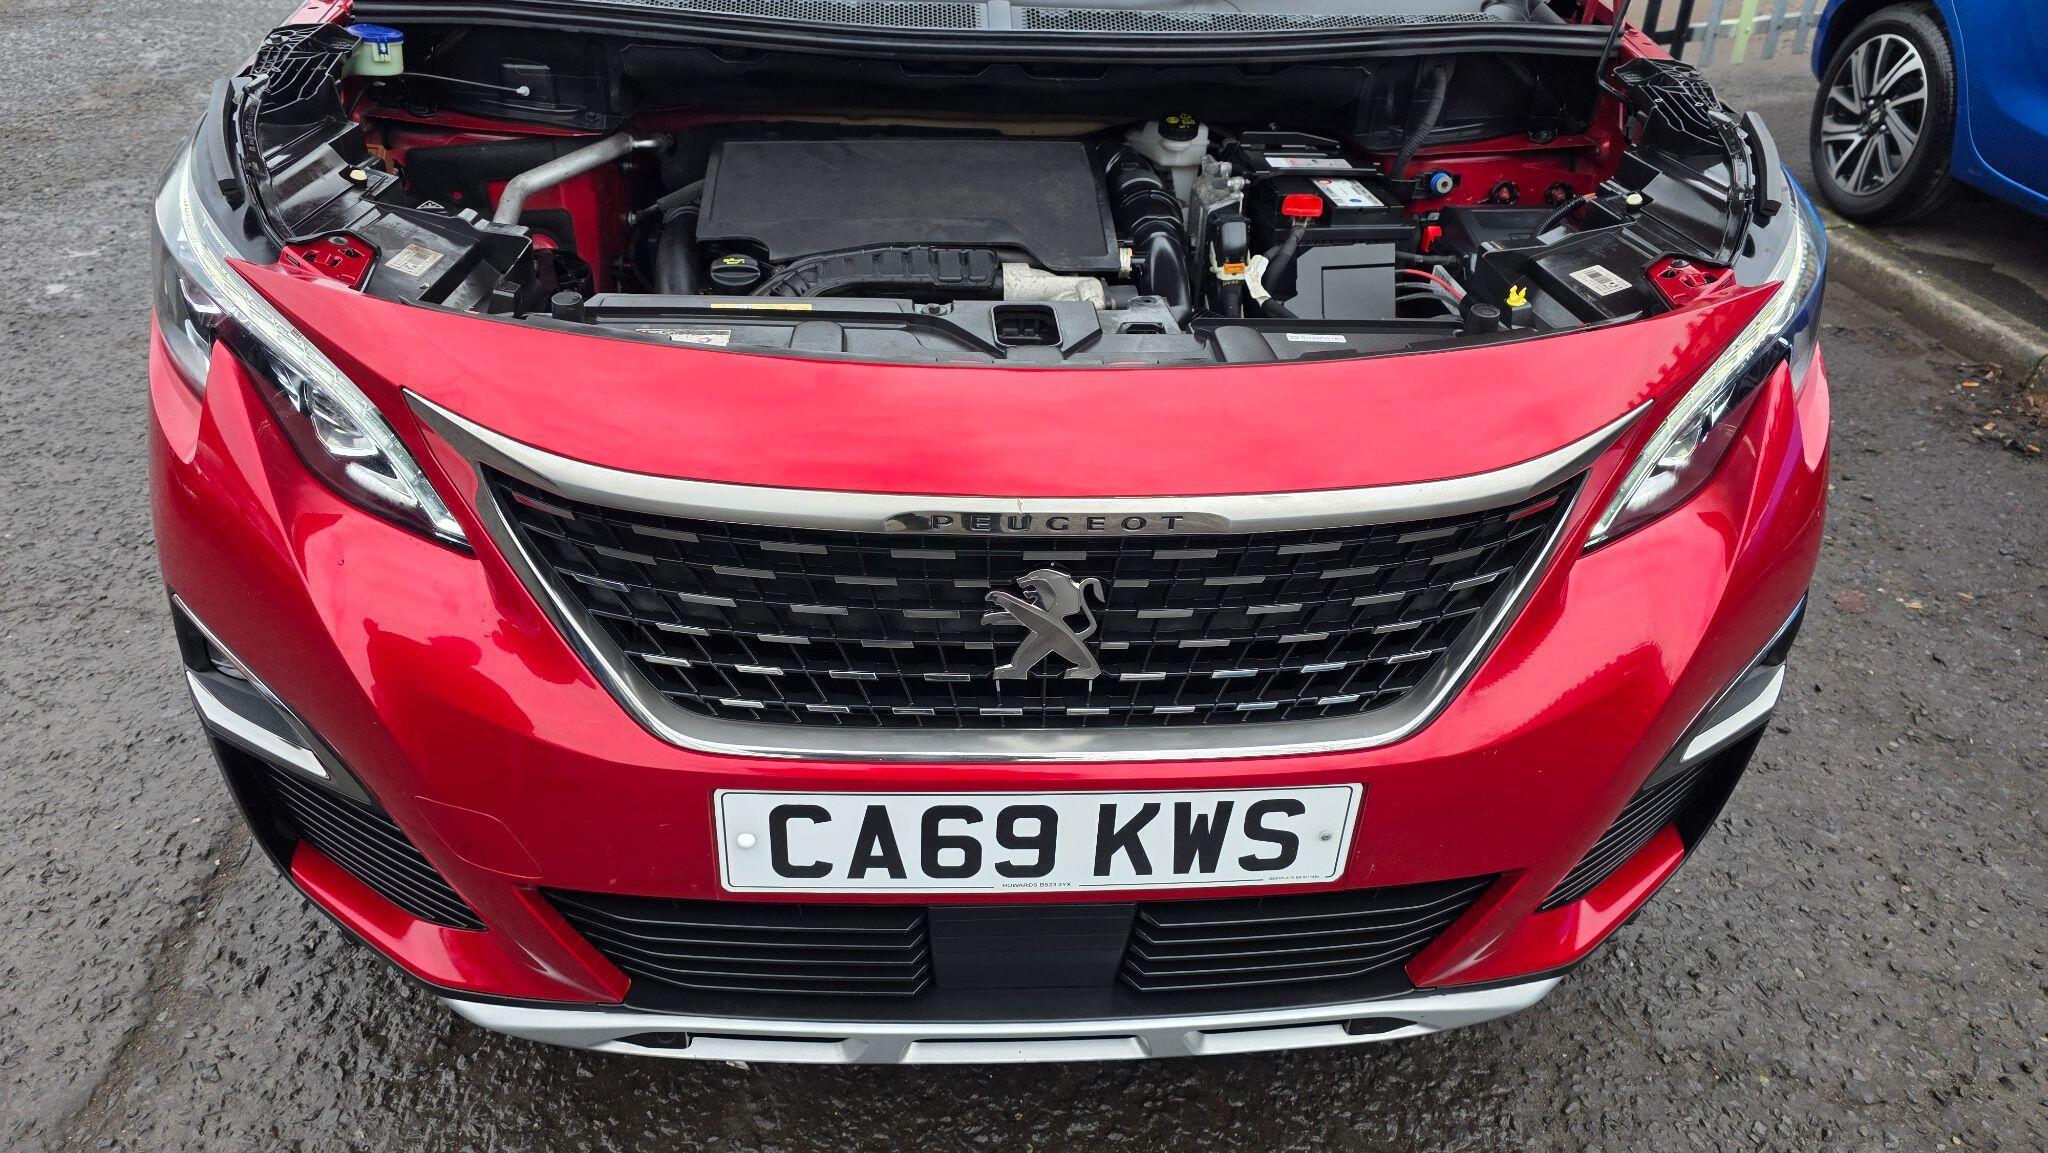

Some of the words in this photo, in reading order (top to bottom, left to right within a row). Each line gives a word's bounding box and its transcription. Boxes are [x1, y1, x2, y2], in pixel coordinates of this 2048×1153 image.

[930, 514, 1184, 532] PEUGEOT
[768, 804, 1059, 879] CA69
[1093, 798, 1306, 877] KWS
